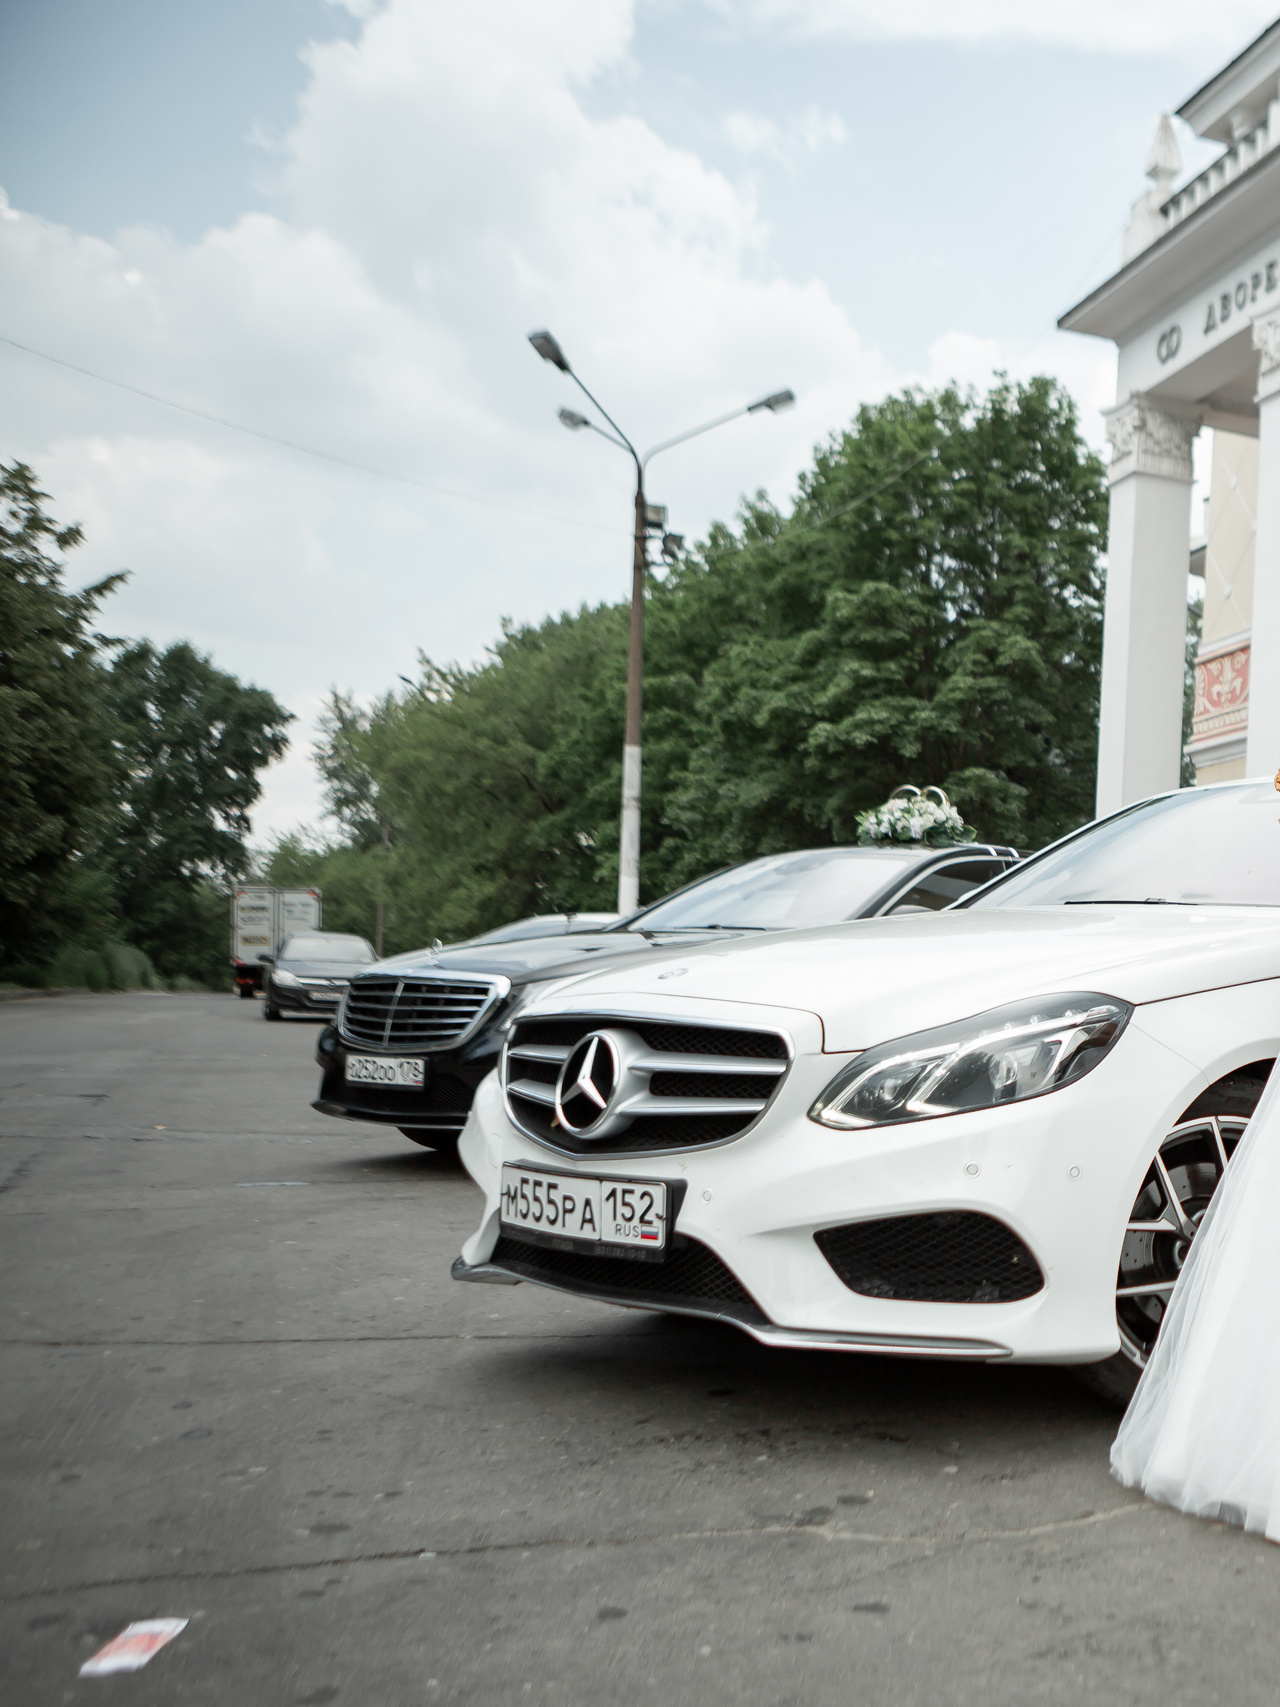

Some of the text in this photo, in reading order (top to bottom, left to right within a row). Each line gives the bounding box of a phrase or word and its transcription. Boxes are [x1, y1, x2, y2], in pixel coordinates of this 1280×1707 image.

[506, 1177, 655, 1233] М555РА 152
[615, 1224, 640, 1238] RUS
